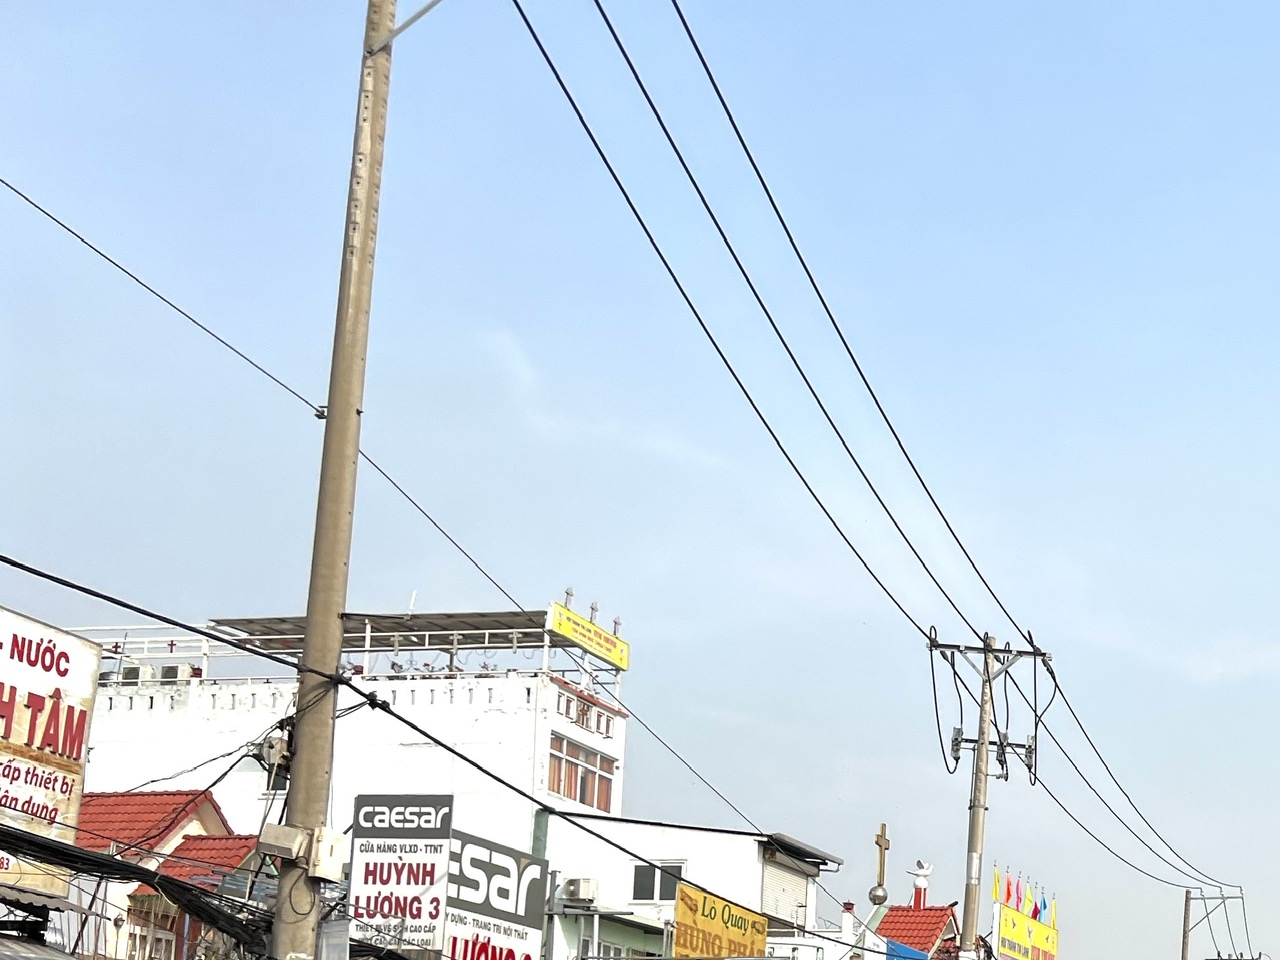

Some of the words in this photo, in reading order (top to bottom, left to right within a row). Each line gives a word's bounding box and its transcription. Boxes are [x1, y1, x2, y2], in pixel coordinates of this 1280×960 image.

[10, 633, 70, 677] NƯỚC
[24, 687, 88, 760] TÂM
[0, 758, 21, 785] ấp
[24, 766, 58, 792] thiết
[60, 776, 75, 801] bị
[21, 796, 59, 826] dụng
[359, 806, 449, 828] caesar
[360, 841, 374, 853] CỬA
[377, 842, 397, 853] HÀNG
[400, 845, 418, 853] VLXD
[425, 845, 443, 853] TTNT
[364, 856, 435, 885] HUỲNH
[354, 891, 422, 919] LƯƠNG
[429, 897, 440, 920] 3
[701, 896, 716, 920] Lò
[722, 904, 749, 936] Quay
[472, 918, 491, 931] TRANG
